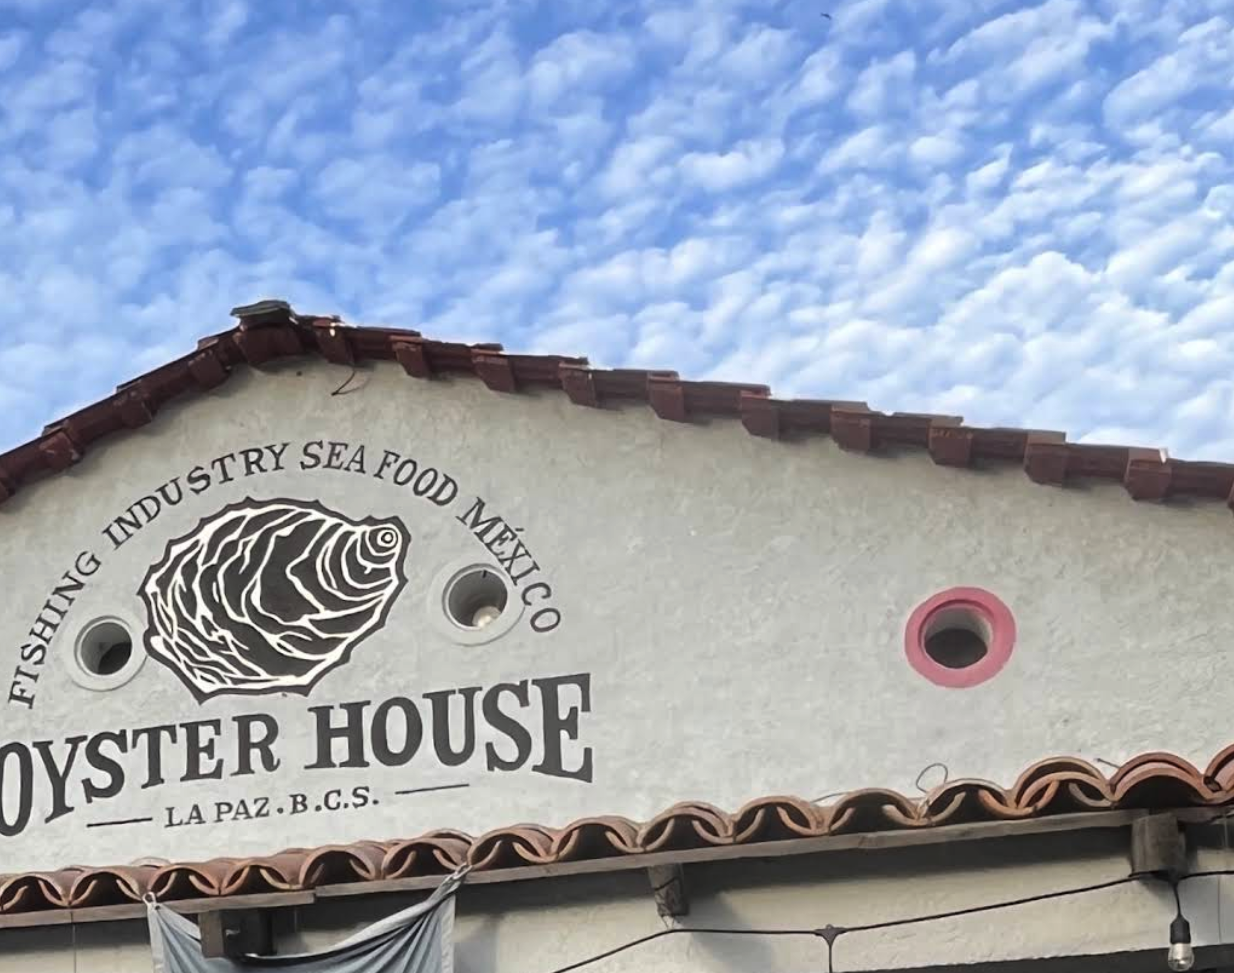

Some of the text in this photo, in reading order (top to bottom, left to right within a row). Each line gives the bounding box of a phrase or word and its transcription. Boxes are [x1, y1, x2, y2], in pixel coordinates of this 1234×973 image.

[7, 439, 561, 710] FISHING INDUSTRY SEA FOOD MÉXICO
[303, 672, 594, 784] HOUSE
[164, 804, 206, 828] LA
